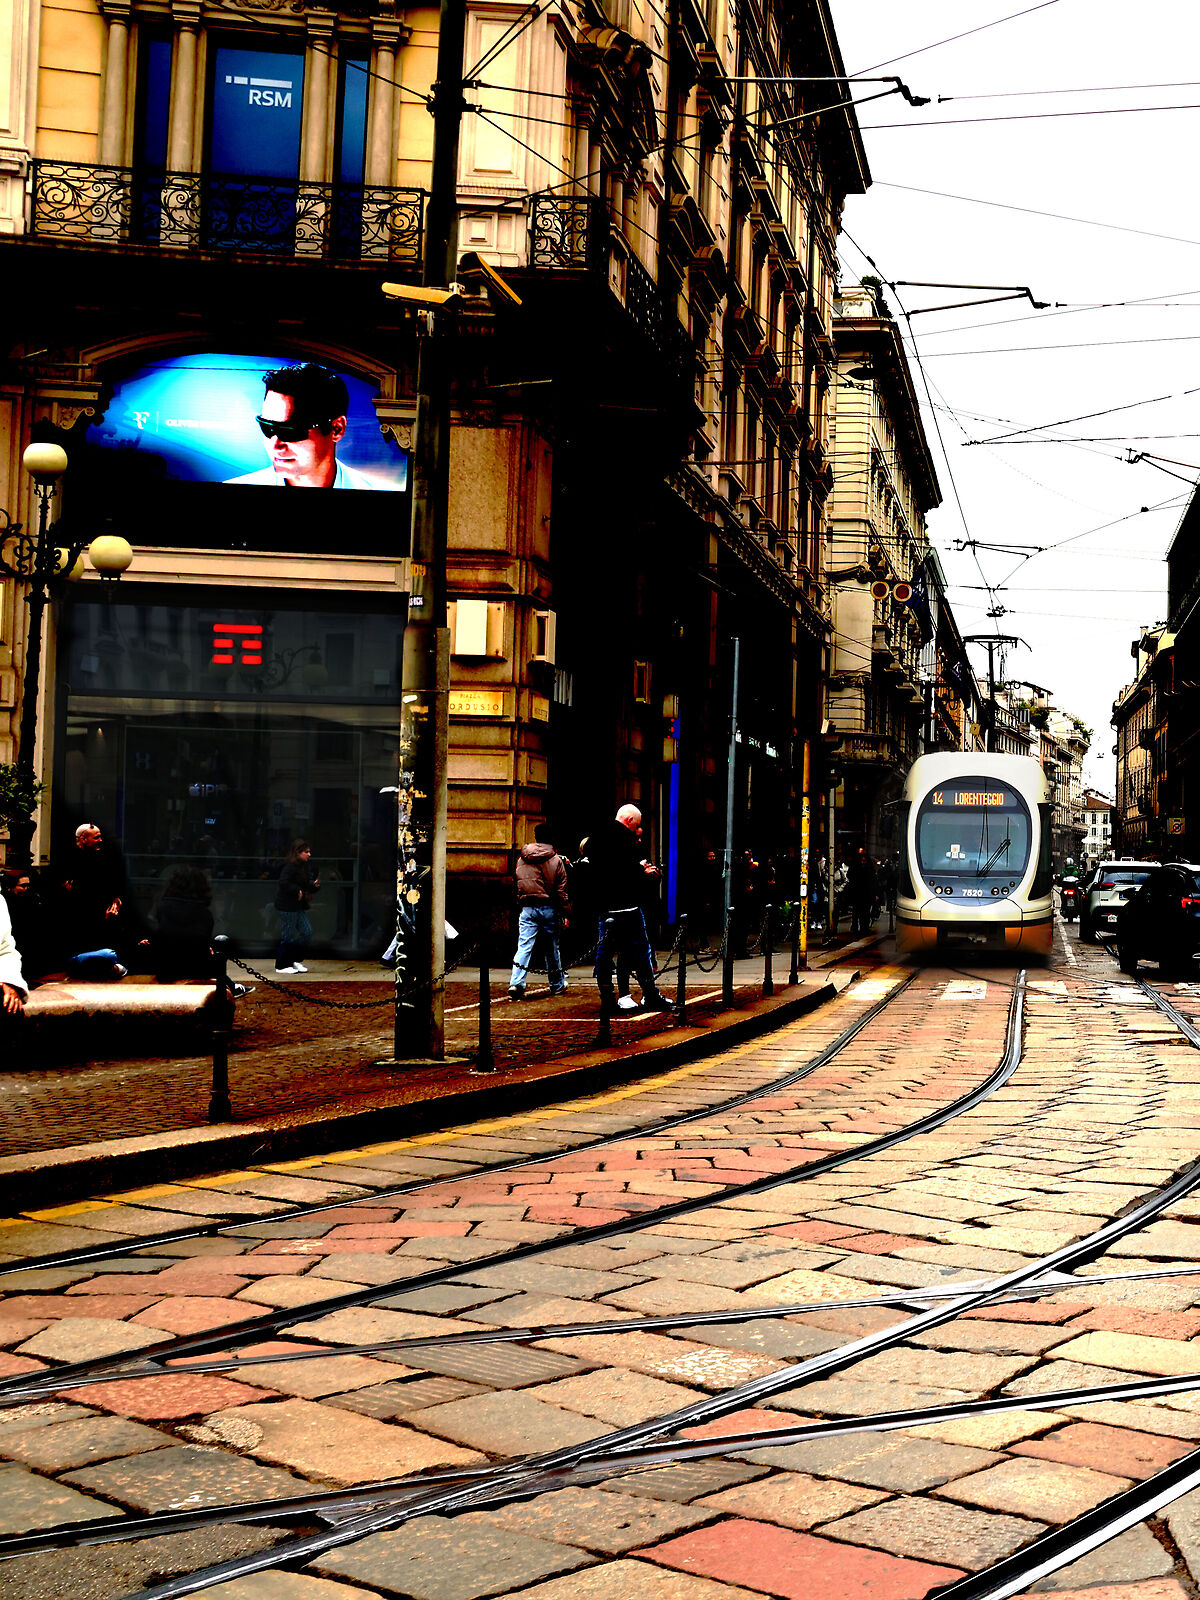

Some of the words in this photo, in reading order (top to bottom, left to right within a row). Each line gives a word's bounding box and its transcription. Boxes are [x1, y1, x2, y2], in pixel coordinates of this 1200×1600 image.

[249, 89, 292, 108] RSM
[449, 703, 500, 711] ORDUSIO
[932, 792, 944, 805] 14
[954, 792, 1006, 806] LORENTEGGIO
[962, 888, 983, 897] 7520
